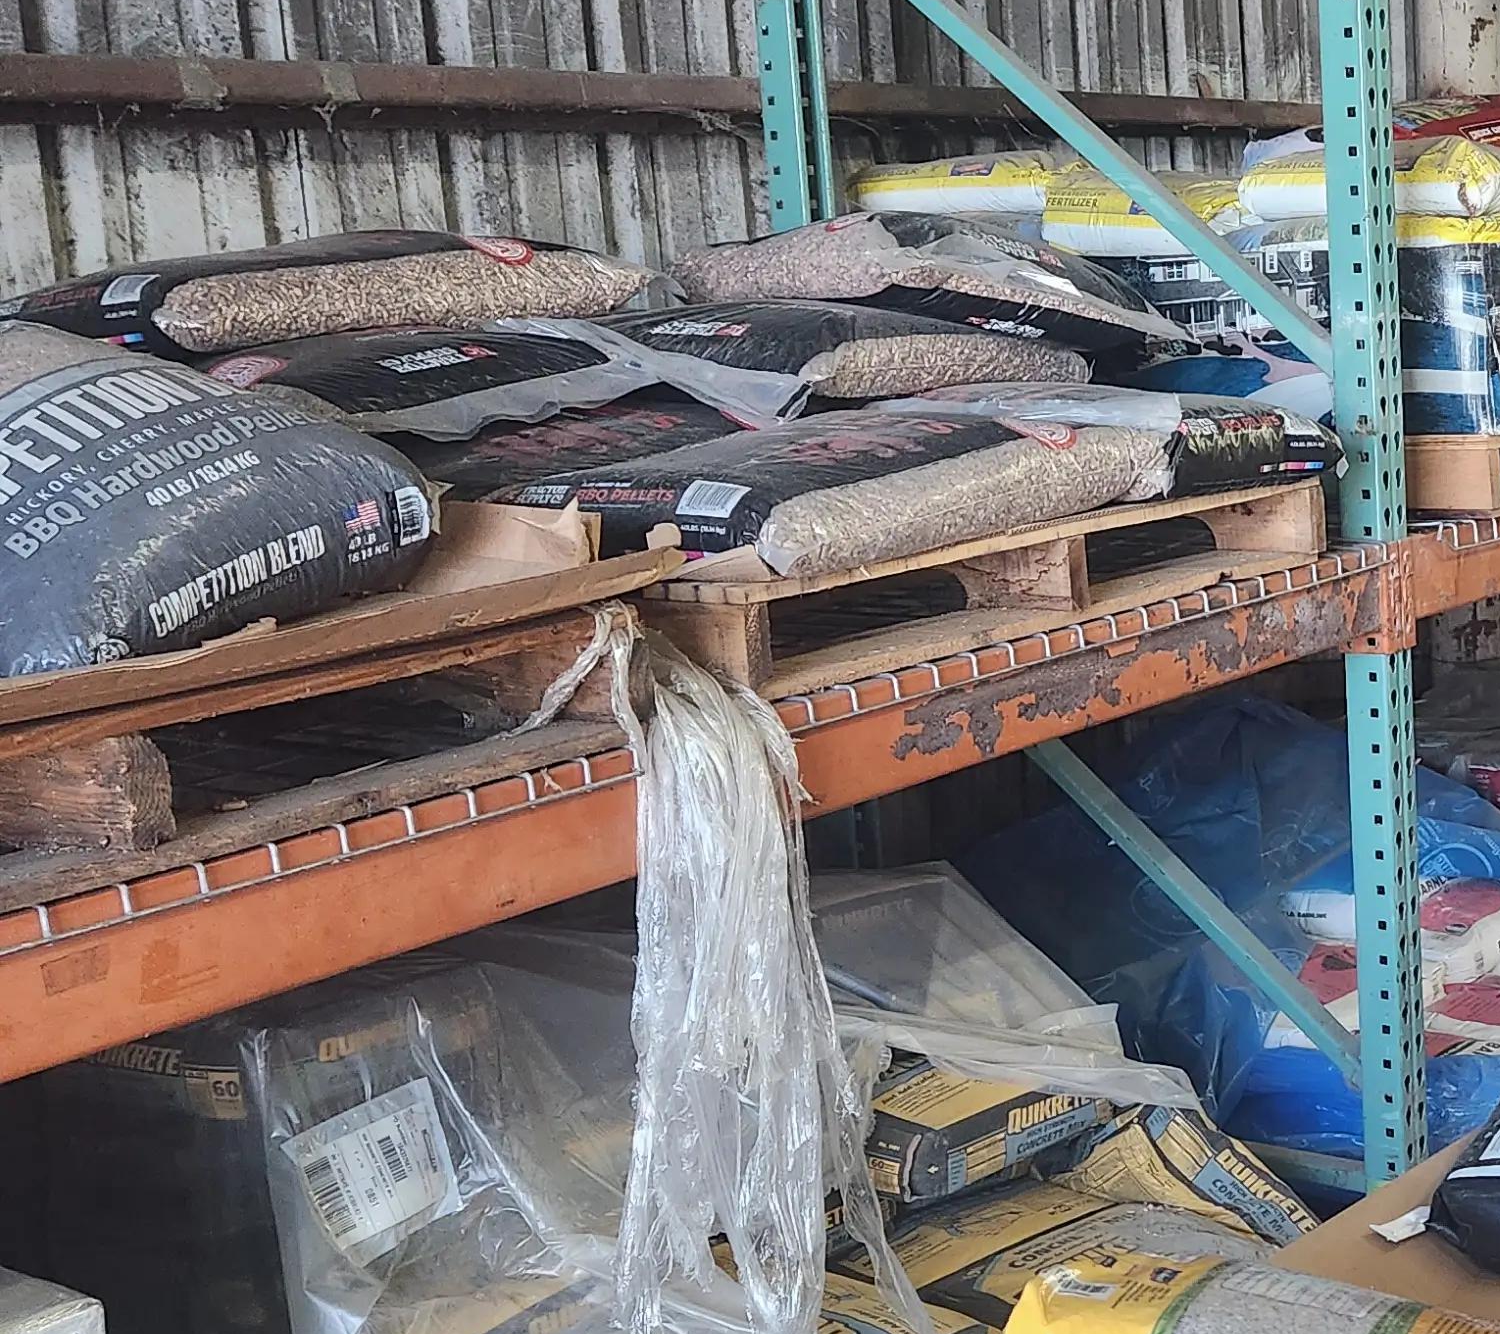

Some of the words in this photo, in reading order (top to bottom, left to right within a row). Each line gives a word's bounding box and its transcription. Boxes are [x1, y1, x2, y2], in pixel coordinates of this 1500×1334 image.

[1046, 196, 1098, 209] FERTILIZER
[0, 369, 202, 505] PETITION
[6, 462, 96, 526] HICKORY,
[97, 422, 176, 463] CHERRY,
[179, 402, 234, 427] MAPLE
[144, 485, 170, 508] 40
[169, 478, 191, 496] LB
[199, 458, 239, 485] 18.14
[237, 449, 261, 471] KG
[4, 498, 87, 559] BBQ
[79, 423, 238, 511] Hardwood
[612, 487, 676, 502] PELLETS
[364, 532, 377, 544] LB
[374, 541, 391, 555] KG
[149, 557, 267, 638] COMPETITION
[269, 525, 325, 576] BLEND
[212, 1080, 240, 1098] 60
[1017, 1128, 1067, 1154] CONCRETE
[1215, 1147, 1320, 1235] QUIKRETE
